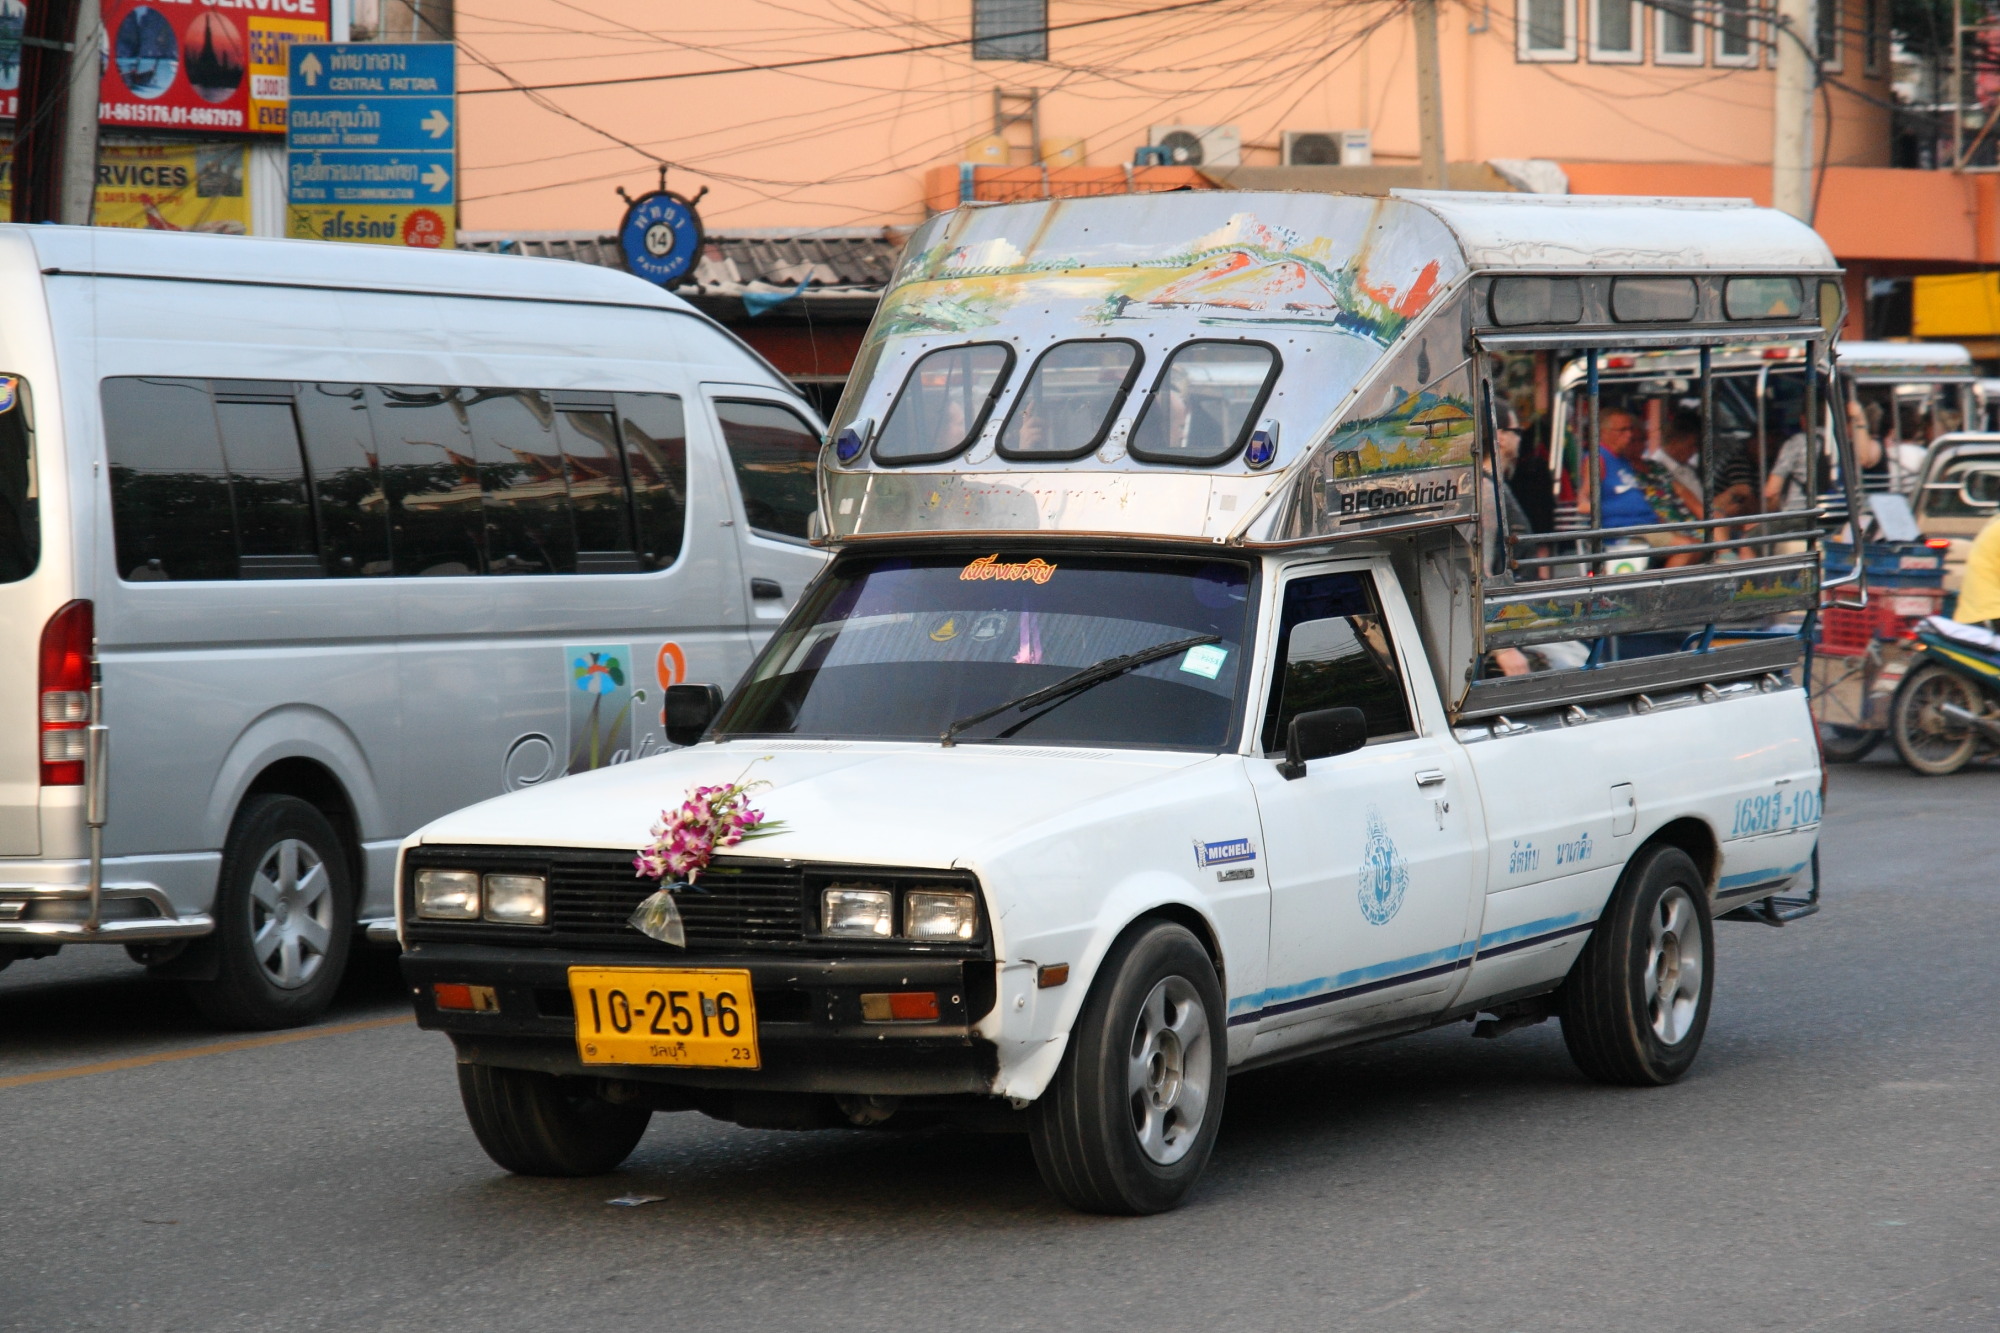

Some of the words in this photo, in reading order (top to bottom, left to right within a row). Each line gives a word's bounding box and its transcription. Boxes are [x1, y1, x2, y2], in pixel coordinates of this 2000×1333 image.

[330, 47, 406, 71] พัทยากลาง
[329, 77, 385, 91] CENTRAL
[389, 77, 438, 91] PATTAYA
[650, 231, 668, 248] 14
[1340, 480, 1458, 516] BFGoodrich
[588, 988, 740, 1037] 10-2516
[650, 1041, 687, 1061] ชลบุรี
[731, 1047, 751, 1060] 23
